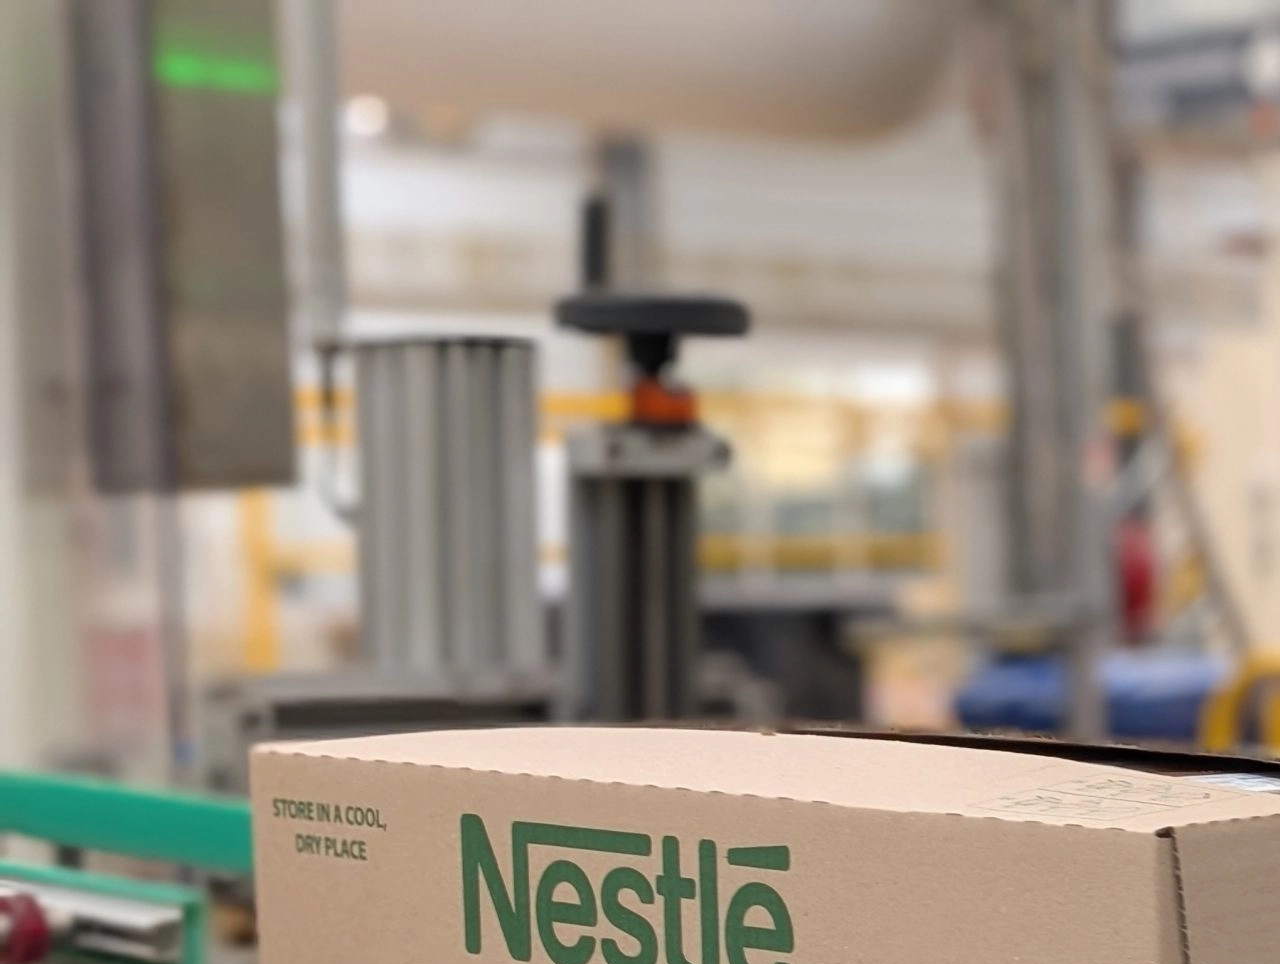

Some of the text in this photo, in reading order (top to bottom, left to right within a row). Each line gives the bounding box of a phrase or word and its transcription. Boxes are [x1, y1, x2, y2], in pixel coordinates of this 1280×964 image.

[272, 798, 388, 832] STORE IN A COOL,
[295, 833, 368, 861] DRY PLACE
